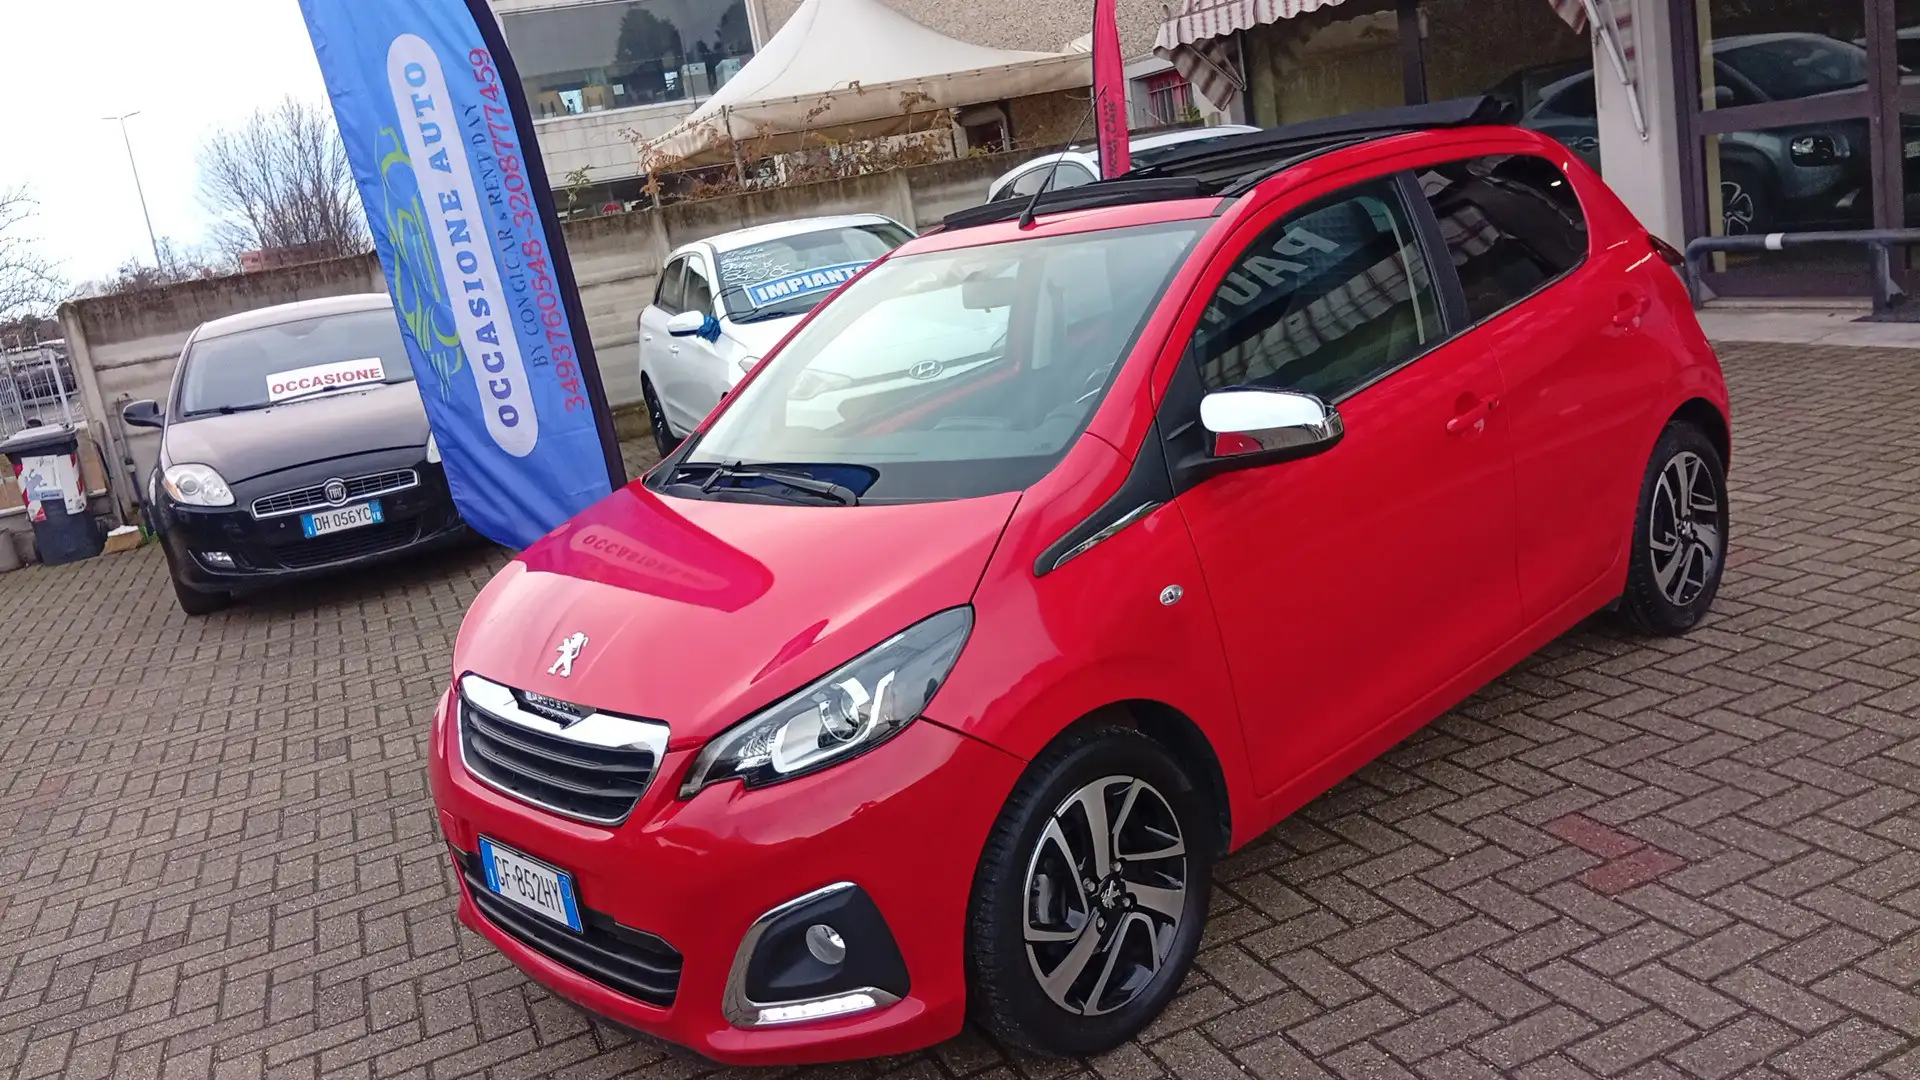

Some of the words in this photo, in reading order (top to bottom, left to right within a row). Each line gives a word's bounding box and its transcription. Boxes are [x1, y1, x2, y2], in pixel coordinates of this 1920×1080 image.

[404, 61, 452, 174] AUTO
[461, 103, 486, 146] DAY
[476, 153, 503, 207] RENT
[468, 47, 587, 413] 3493760548-3208777459
[438, 189, 520, 428] OCCASIONE
[531, 342, 549, 368] BY
[271, 368, 382, 394] OCCASIONE
[329, 487, 343, 499] FIAT
[314, 516, 331, 532] DH
[334, 506, 372, 527] 056YC
